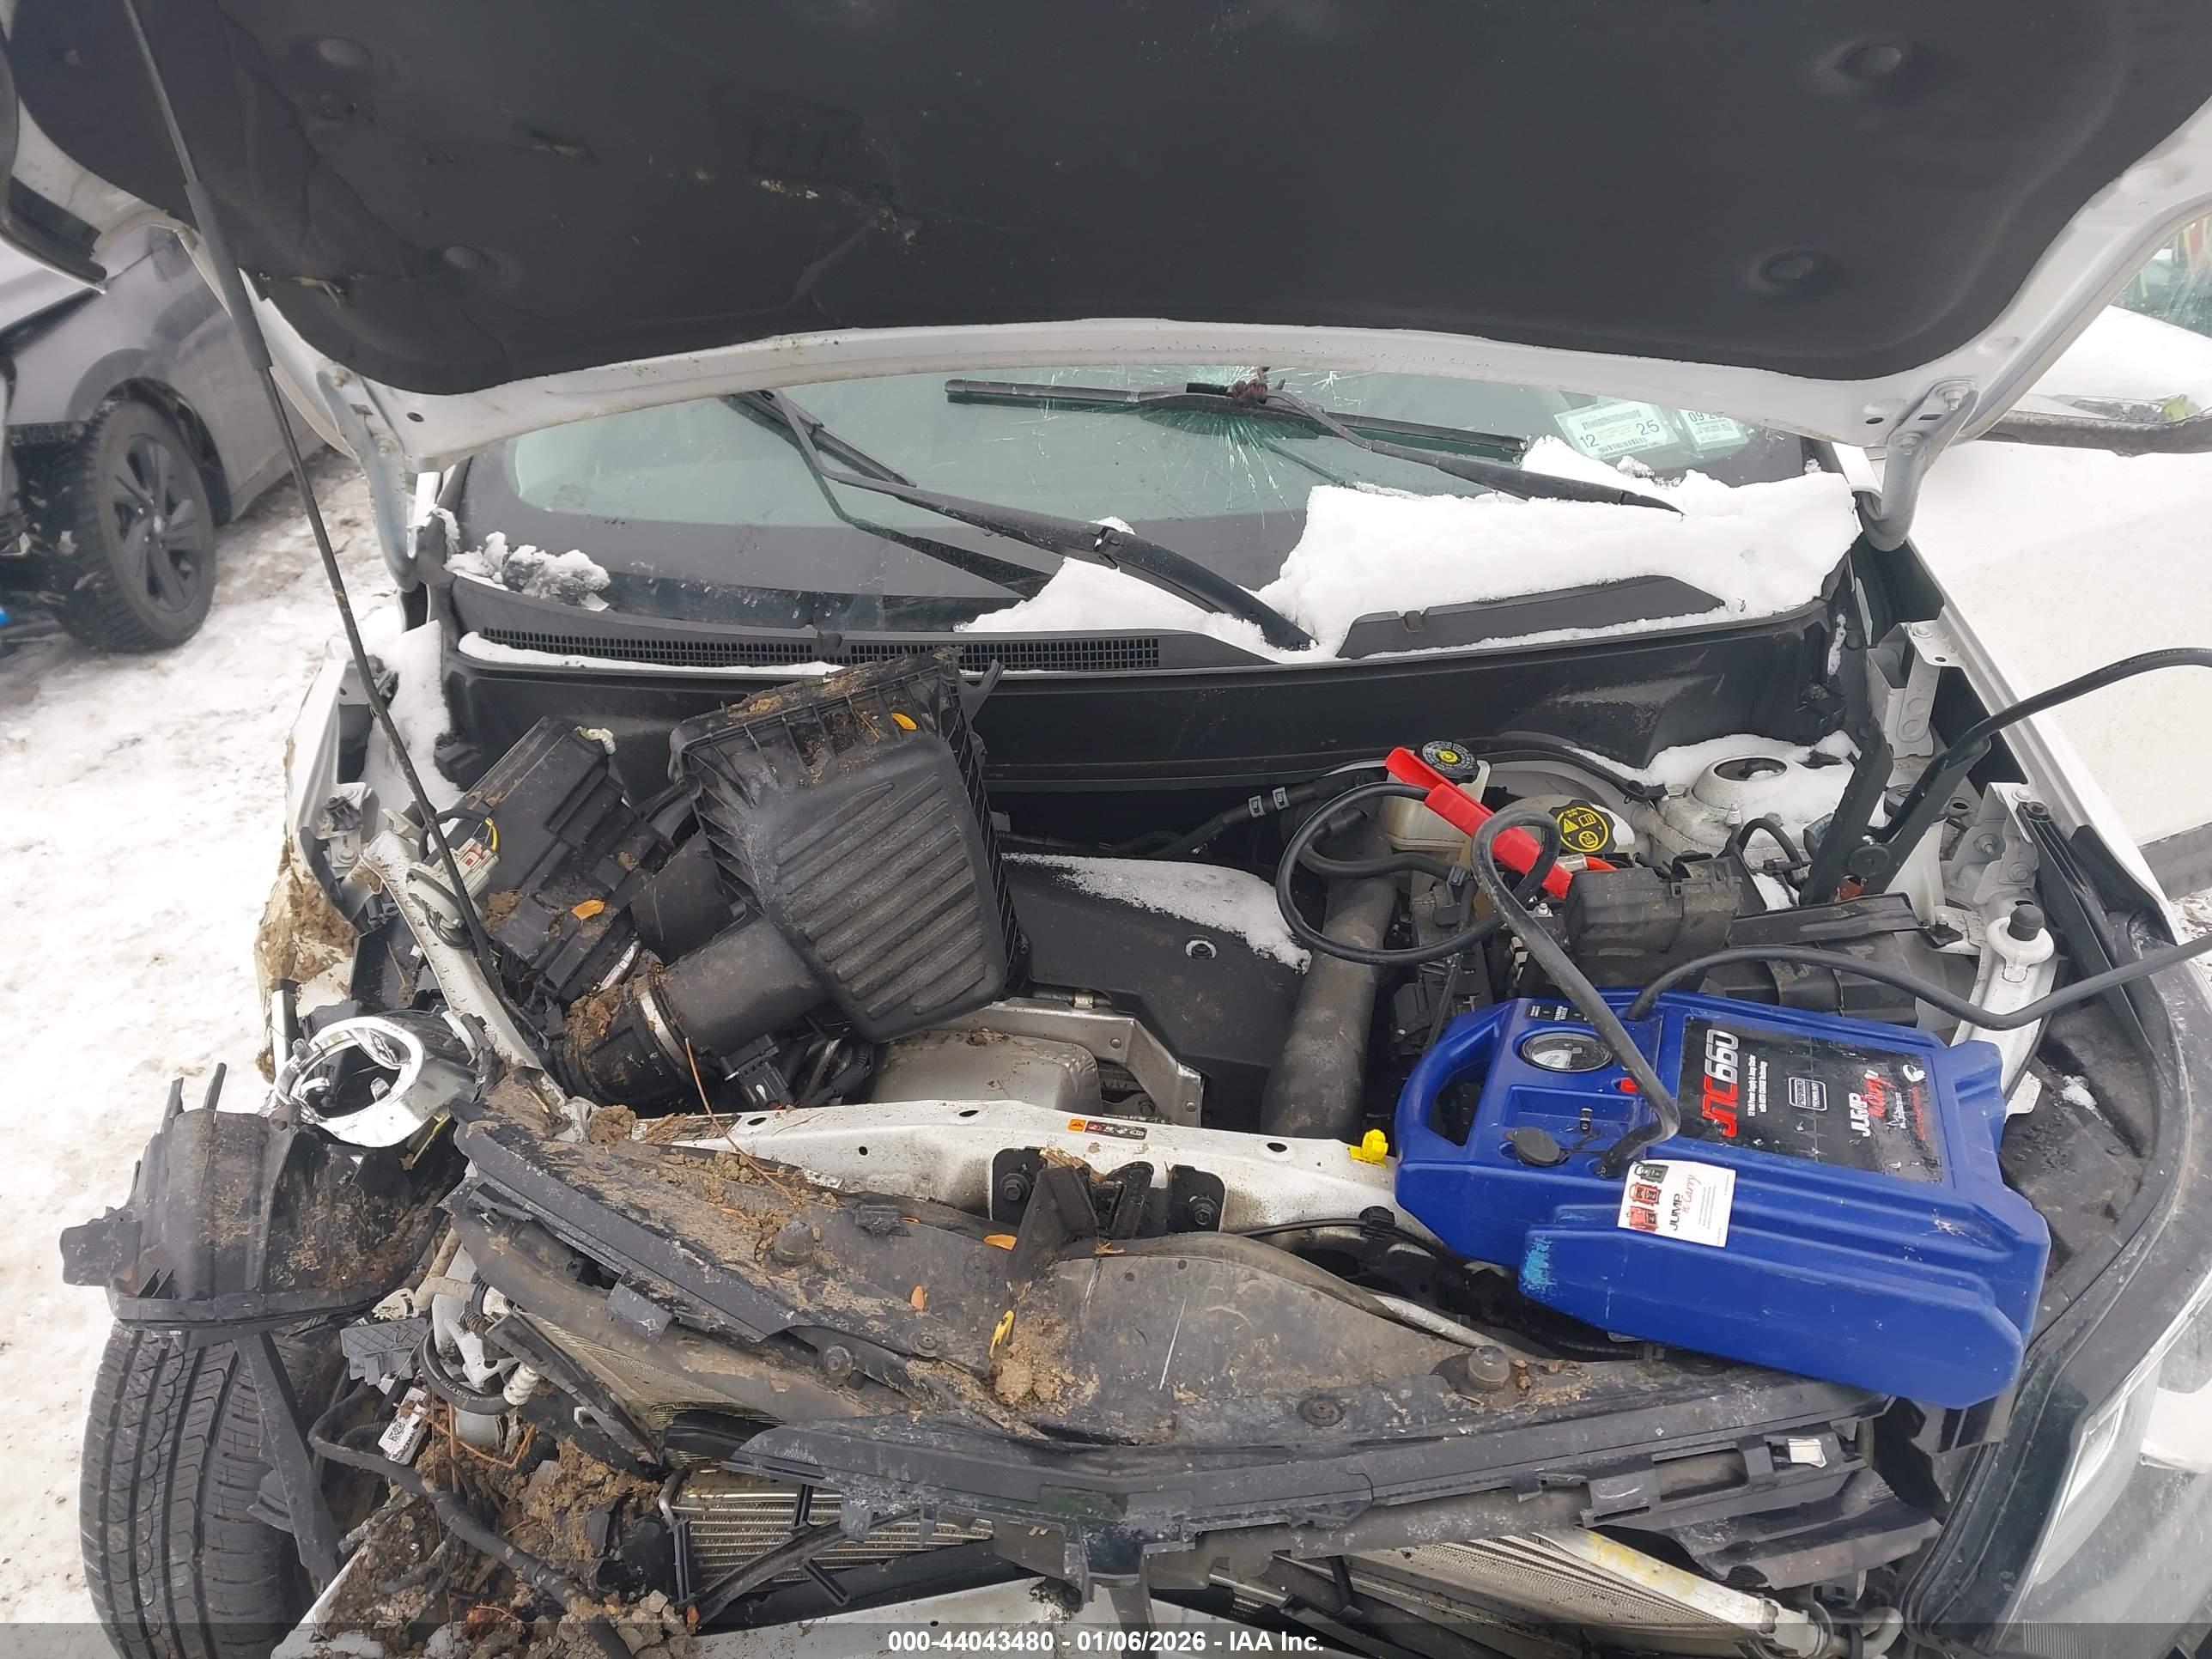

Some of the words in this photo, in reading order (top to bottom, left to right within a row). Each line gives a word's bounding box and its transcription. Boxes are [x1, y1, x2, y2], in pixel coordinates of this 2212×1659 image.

[1579, 434, 1600, 448] 12
[1636, 419, 1660, 435] 25
[1702, 1029, 1739, 1138] JNC660
[1849, 1092, 1871, 1137] JUMP
[1681, 1174, 1702, 1202] Carry
[1669, 1193, 1682, 1231] JUMP
